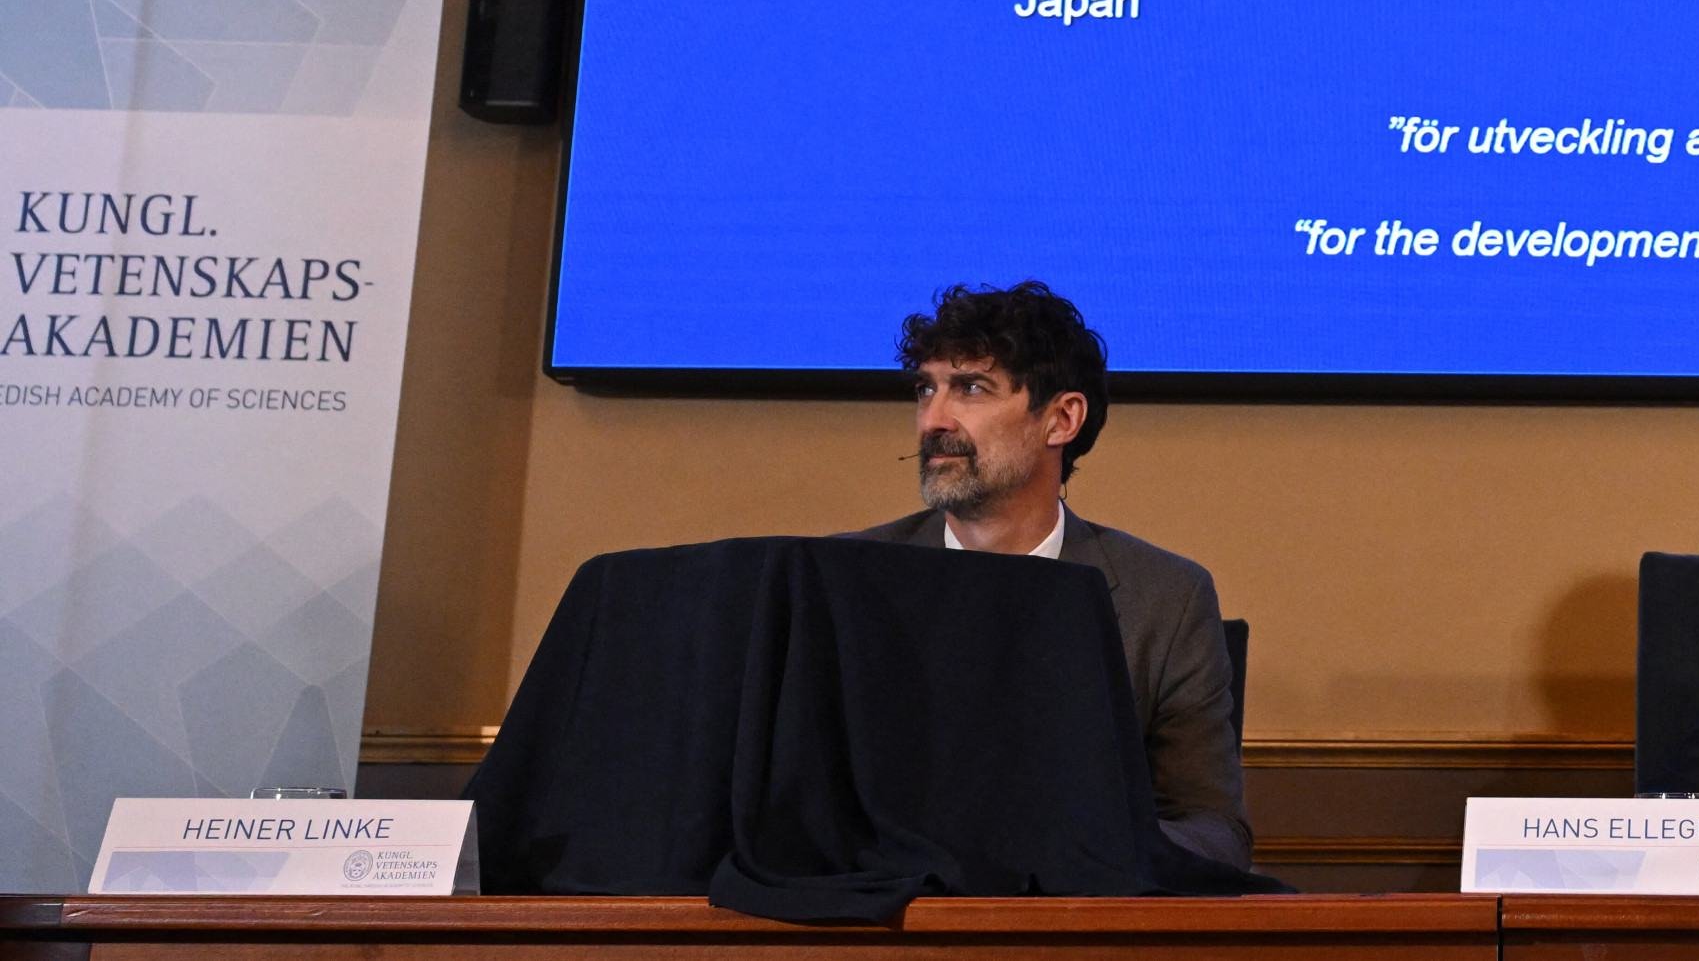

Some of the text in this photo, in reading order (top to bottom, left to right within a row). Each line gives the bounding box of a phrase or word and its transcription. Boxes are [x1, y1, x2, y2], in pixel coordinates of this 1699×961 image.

[1468, 119, 1674, 163] utveckling
[15, 191, 217, 237] KUNGL.
[1375, 220, 1439, 255] the
[11, 252, 374, 302] VETENSKAPS-
[0, 313, 358, 362] AKADEMIEN
[0, 385, 346, 411] DISH ACADEMY OF SCIENCES
[183, 819, 394, 840] HEINER LINKE
[1524, 818, 1598, 838] HANS
